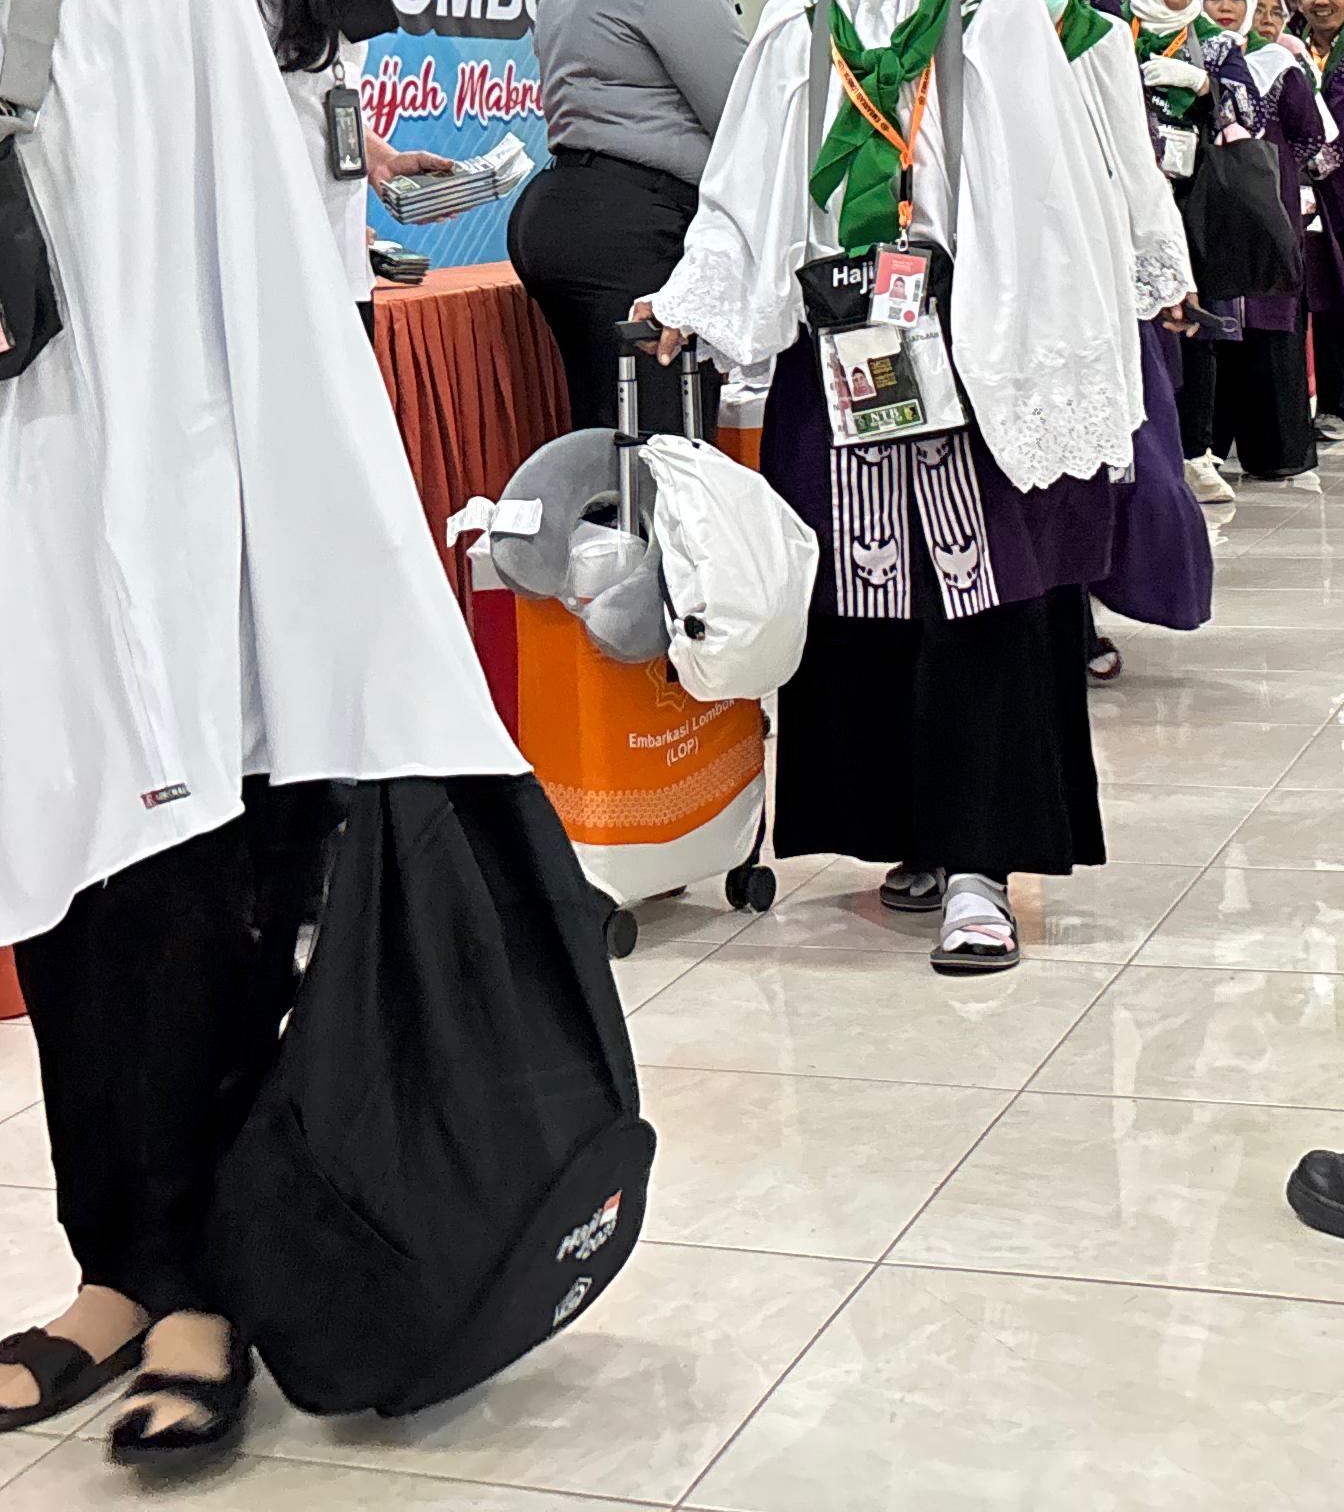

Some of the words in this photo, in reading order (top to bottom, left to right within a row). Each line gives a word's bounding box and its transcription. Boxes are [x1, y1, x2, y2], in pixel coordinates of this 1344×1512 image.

[361, 59, 445, 138] ajjah
[456, 63, 543, 122] Mabr
[832, 260, 874, 294] Haji
[628, 719, 690, 748] Embarkasi
[666, 736, 699, 767] (LOP)
